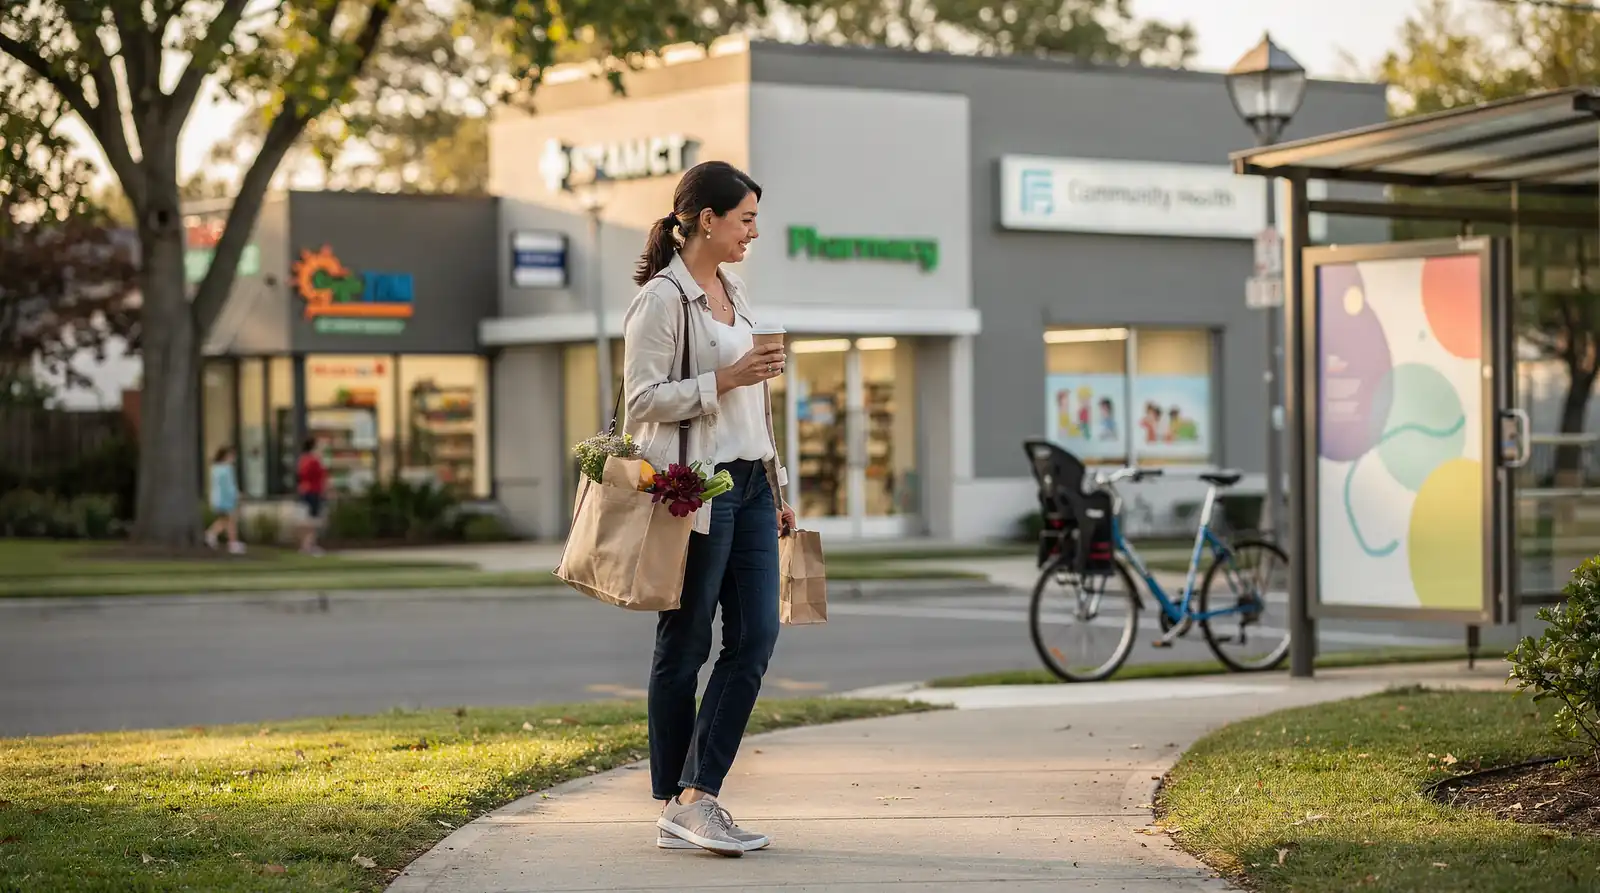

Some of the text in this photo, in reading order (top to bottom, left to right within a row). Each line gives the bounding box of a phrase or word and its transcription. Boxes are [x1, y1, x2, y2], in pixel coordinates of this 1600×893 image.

[1068, 178, 1236, 213] Community Health
[787, 225, 939, 273] Pharmacy
